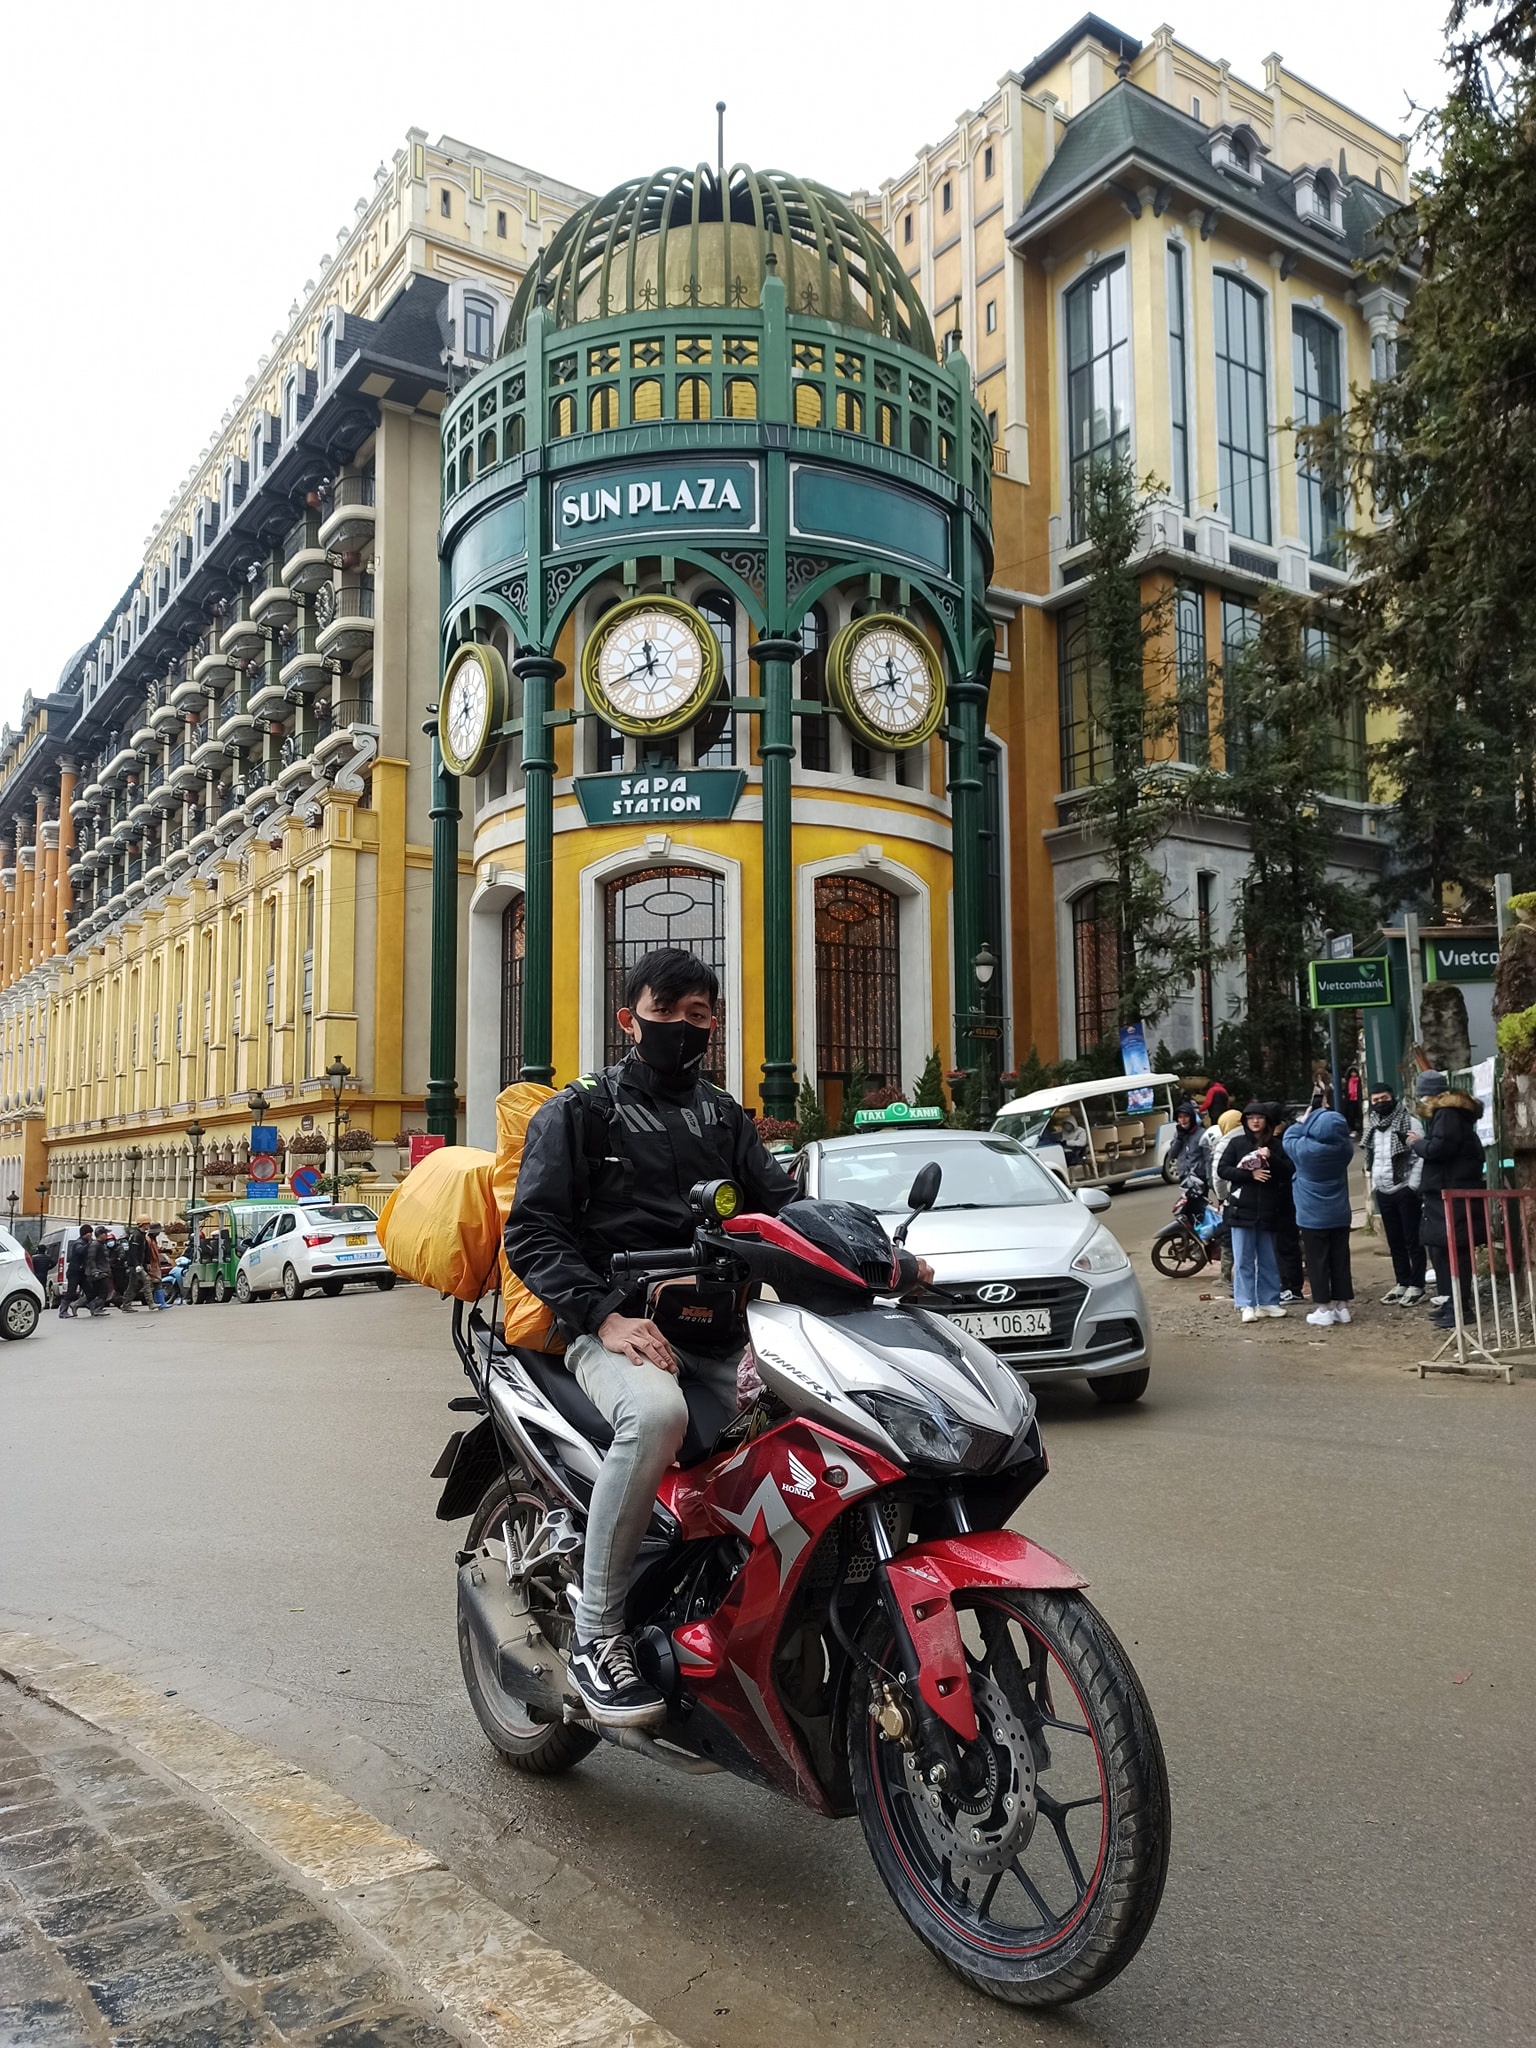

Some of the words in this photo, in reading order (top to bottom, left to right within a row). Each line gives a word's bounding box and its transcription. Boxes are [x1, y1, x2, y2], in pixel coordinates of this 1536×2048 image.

[562, 485, 622, 526] SUN
[628, 478, 742, 515] PLAZA
[620, 776, 687, 796] SAPA
[612, 796, 701, 815] STATION
[1317, 979, 1384, 991] Vietcombank
[863, 1111, 886, 1120] TAXI
[909, 1108, 938, 1118] XANH
[760, 1349, 824, 1391] WINNER
[782, 1483, 816, 1500] HONDA
